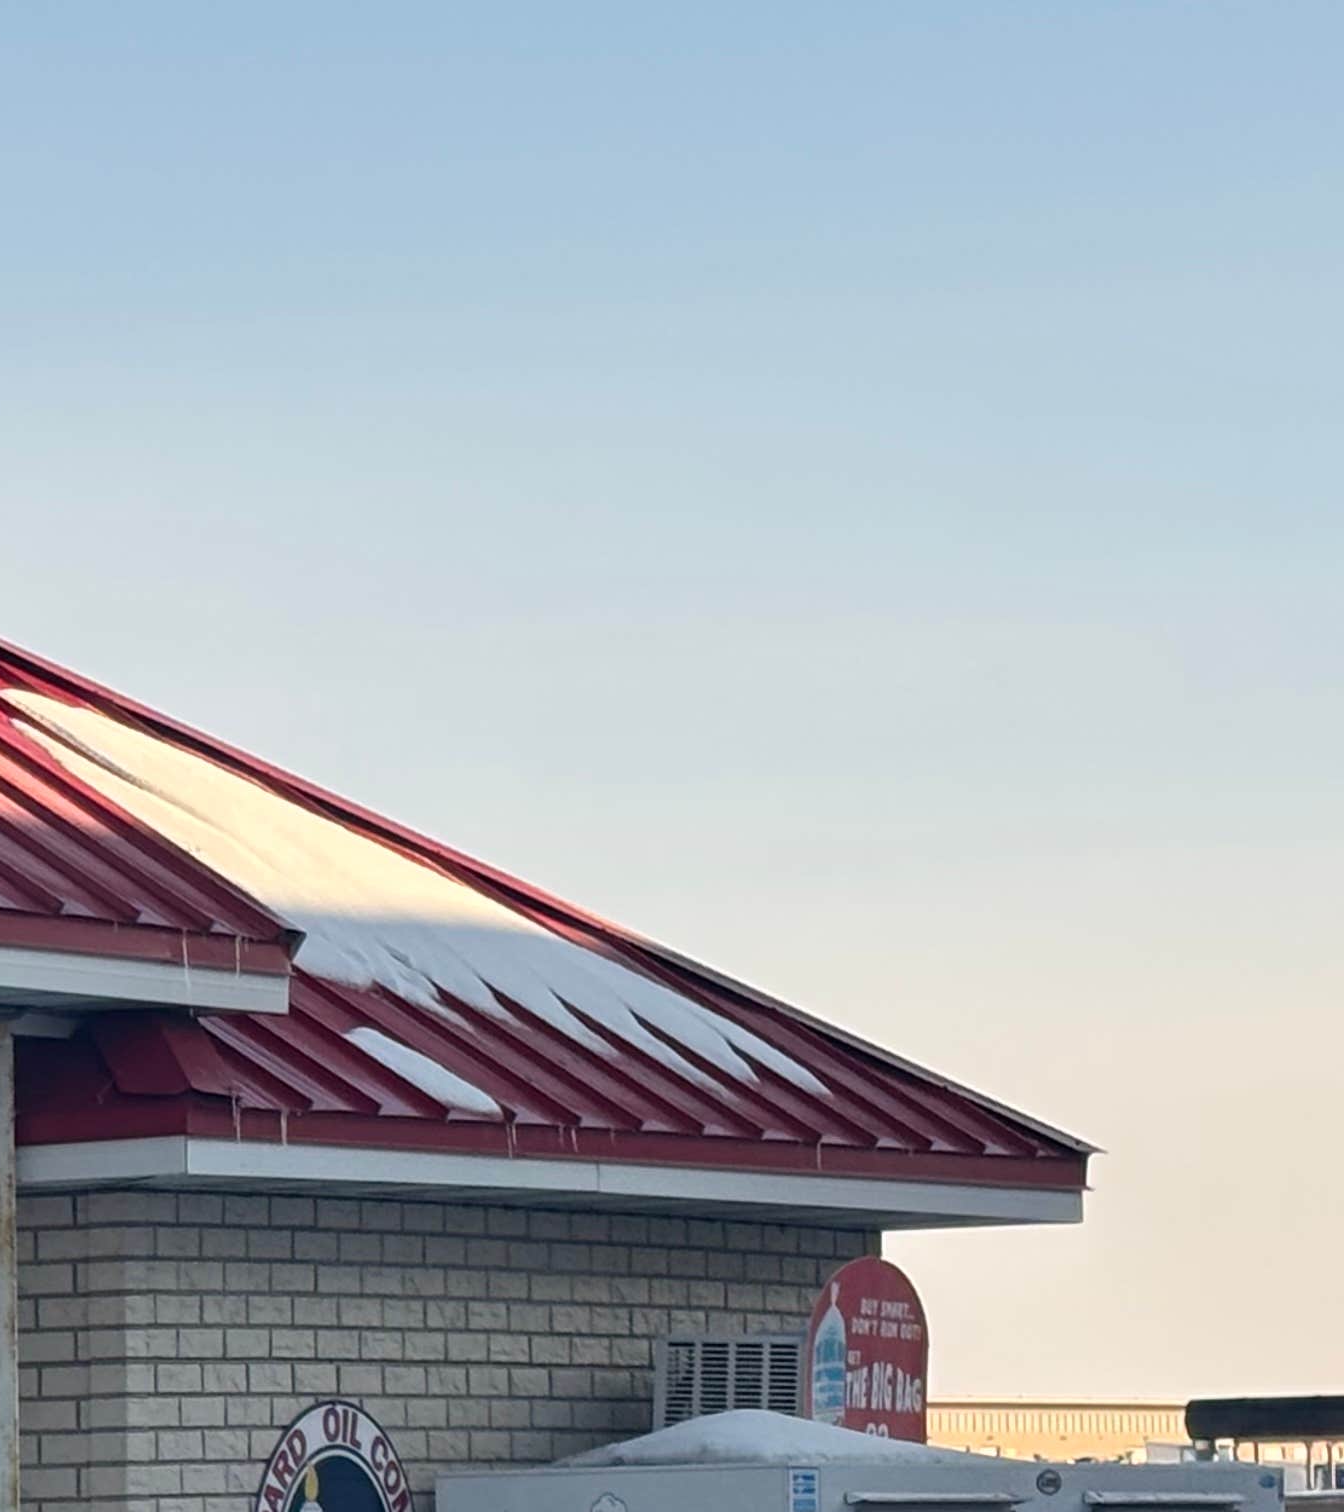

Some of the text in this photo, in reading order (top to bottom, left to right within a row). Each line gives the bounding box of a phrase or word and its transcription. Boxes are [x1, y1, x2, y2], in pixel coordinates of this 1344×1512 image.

[846, 1361, 922, 1413] THE BIG BAG
[322, 1407, 362, 1450] OIL
